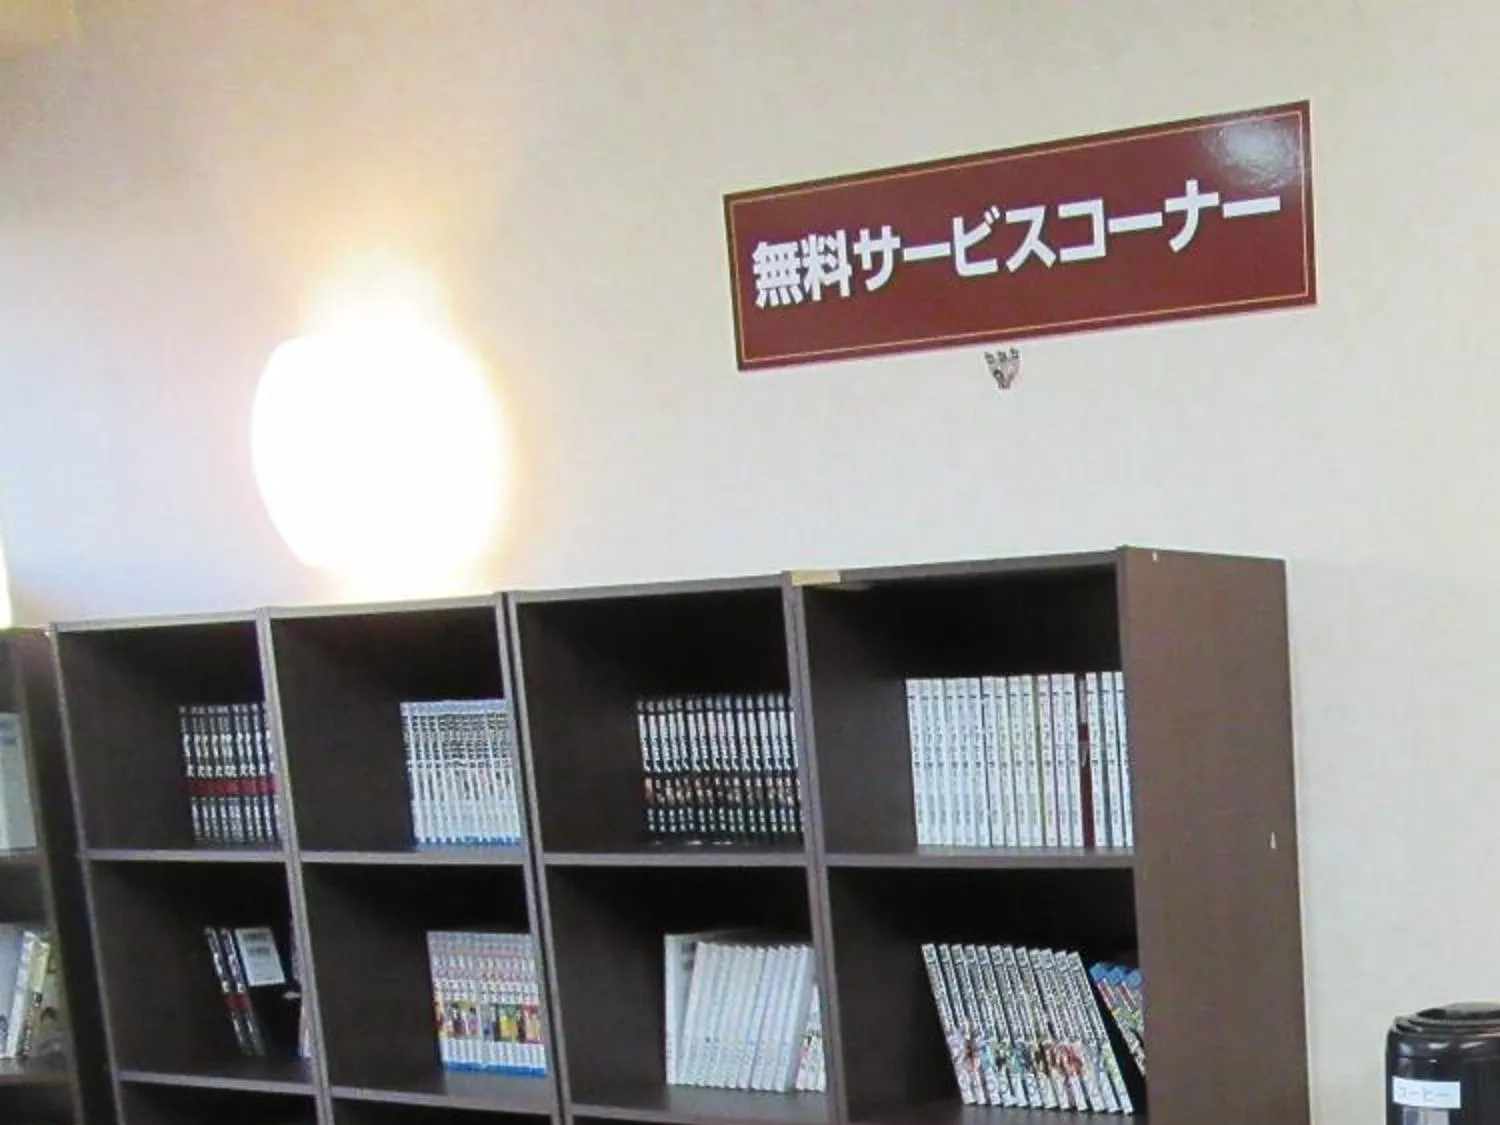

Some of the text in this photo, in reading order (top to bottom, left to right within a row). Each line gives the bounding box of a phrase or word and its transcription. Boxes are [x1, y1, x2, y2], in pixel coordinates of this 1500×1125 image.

[752, 178, 1281, 309] 無料サービスコーナー
